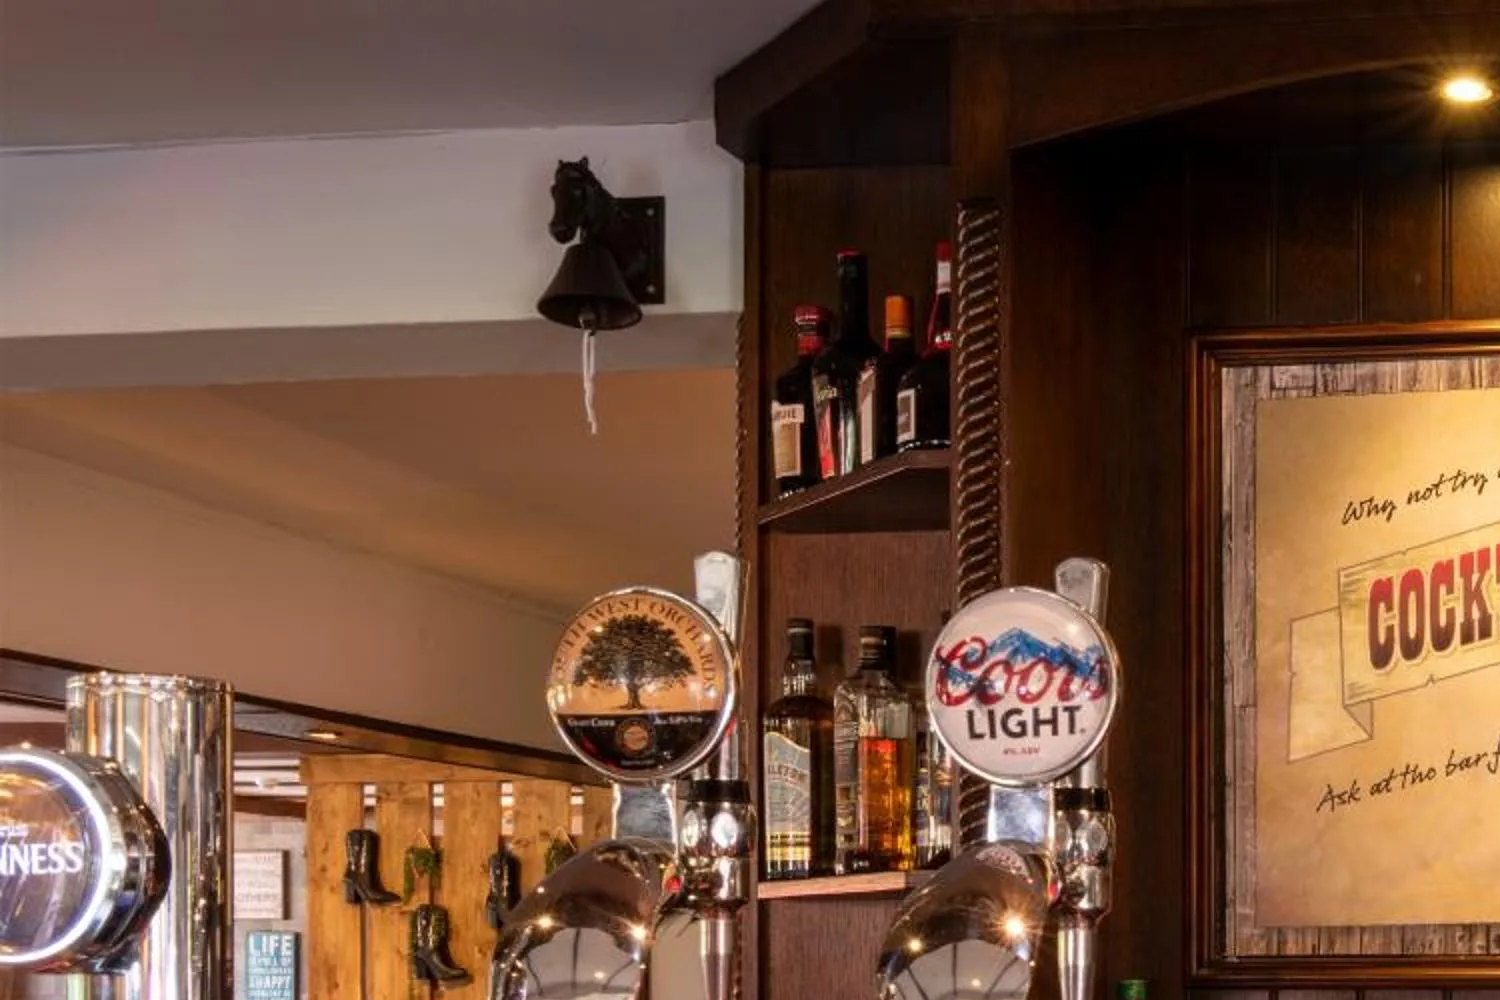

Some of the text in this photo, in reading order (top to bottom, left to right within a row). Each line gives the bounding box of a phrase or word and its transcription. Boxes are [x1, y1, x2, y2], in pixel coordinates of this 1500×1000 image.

[1342, 496, 1398, 525] Why
[1407, 473, 1445, 504] not
[1447, 469, 1489, 495] try
[934, 635, 1109, 707] Coors
[966, 706, 1082, 741] LIGHT
[1316, 780, 1362, 813] Ask
[1369, 770, 1399, 797] at
[1400, 761, 1436, 790] the
[1445, 749, 1485, 778] bar
[0, 842, 84, 876] NESS
[249, 935, 293, 956] LIFE
